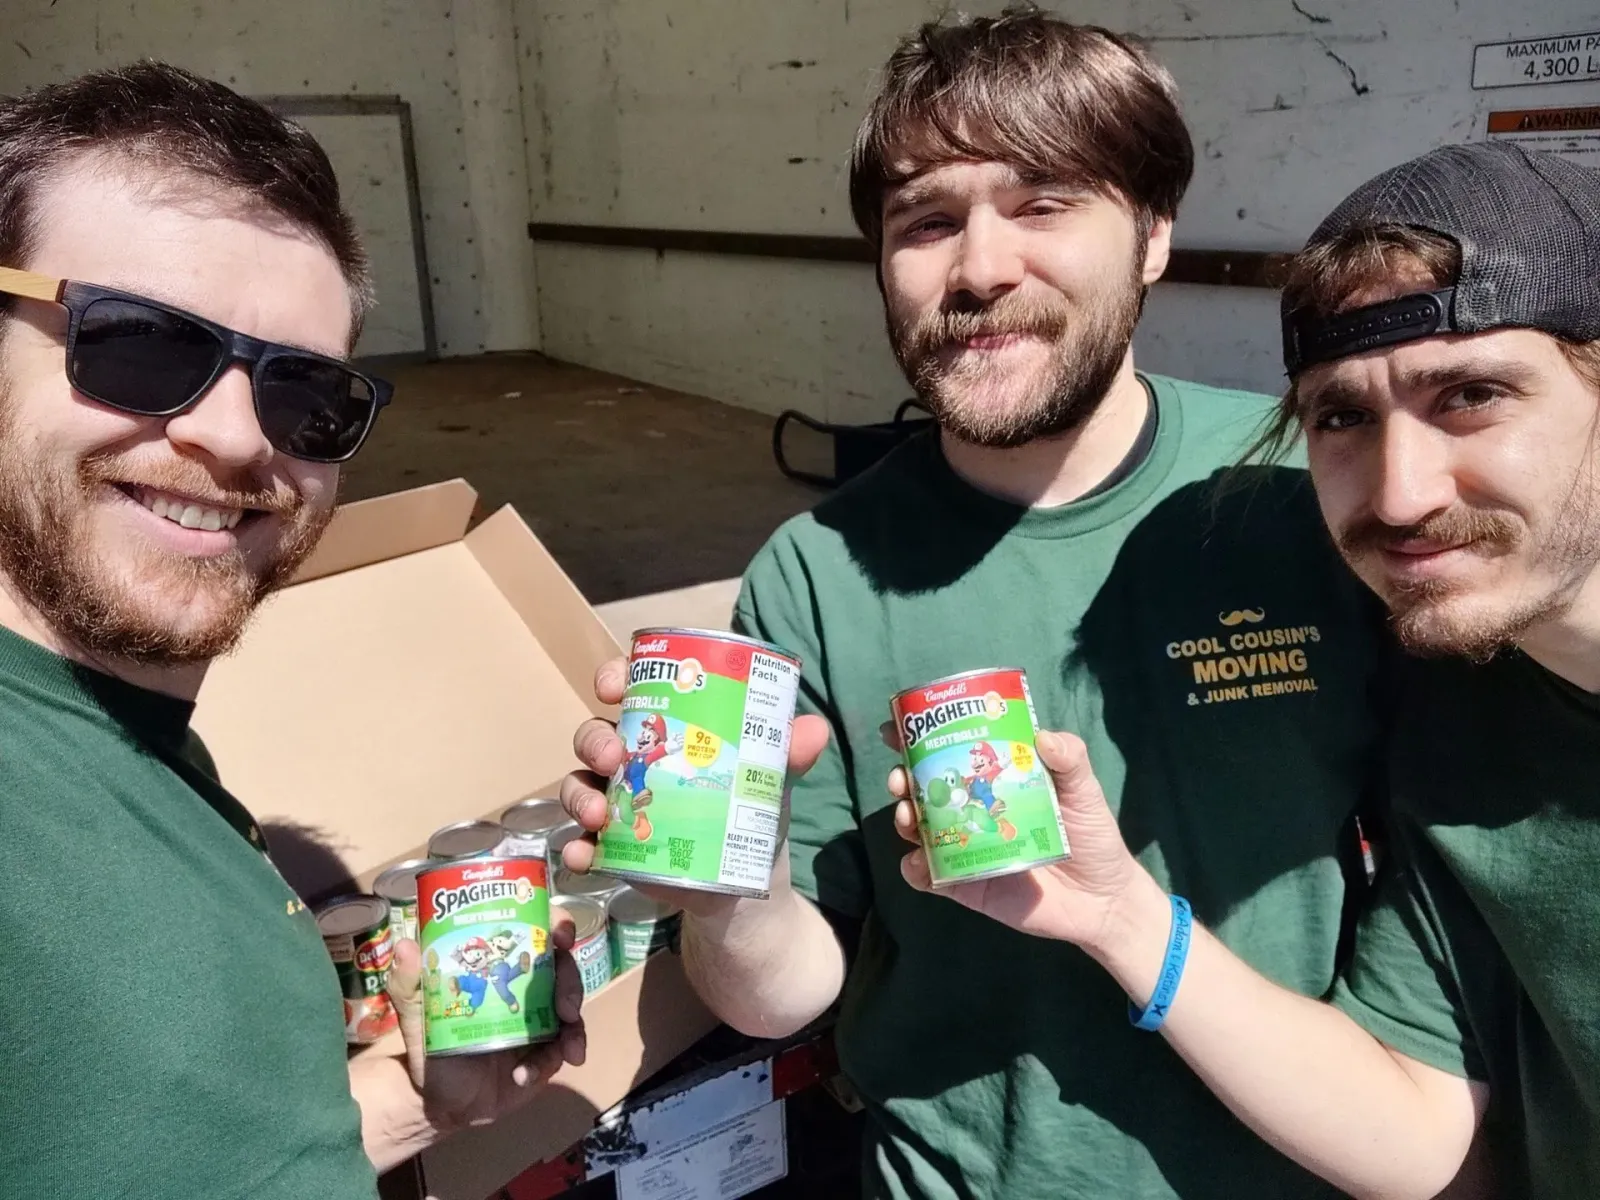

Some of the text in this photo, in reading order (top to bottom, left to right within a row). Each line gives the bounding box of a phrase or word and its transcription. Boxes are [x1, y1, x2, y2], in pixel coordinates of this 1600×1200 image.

[1506, 39, 1581, 58] MAXIMUM
[1524, 56, 1580, 80] 4,300
[1166, 626, 1321, 659] COOL COUSIN'S
[629, 658, 704, 687] GHETTIOS
[752, 667, 778, 682] Facts
[753, 654, 791, 674] Nutrition
[1193, 649, 1308, 685] MOVING
[924, 682, 967, 702] Campbell's
[1187, 678, 1318, 706] & JUNK REMOVAL
[745, 712, 768, 724] Calories
[744, 721, 764, 738] 210
[767, 727, 782, 743] 380
[746, 768, 764, 784] 20%
